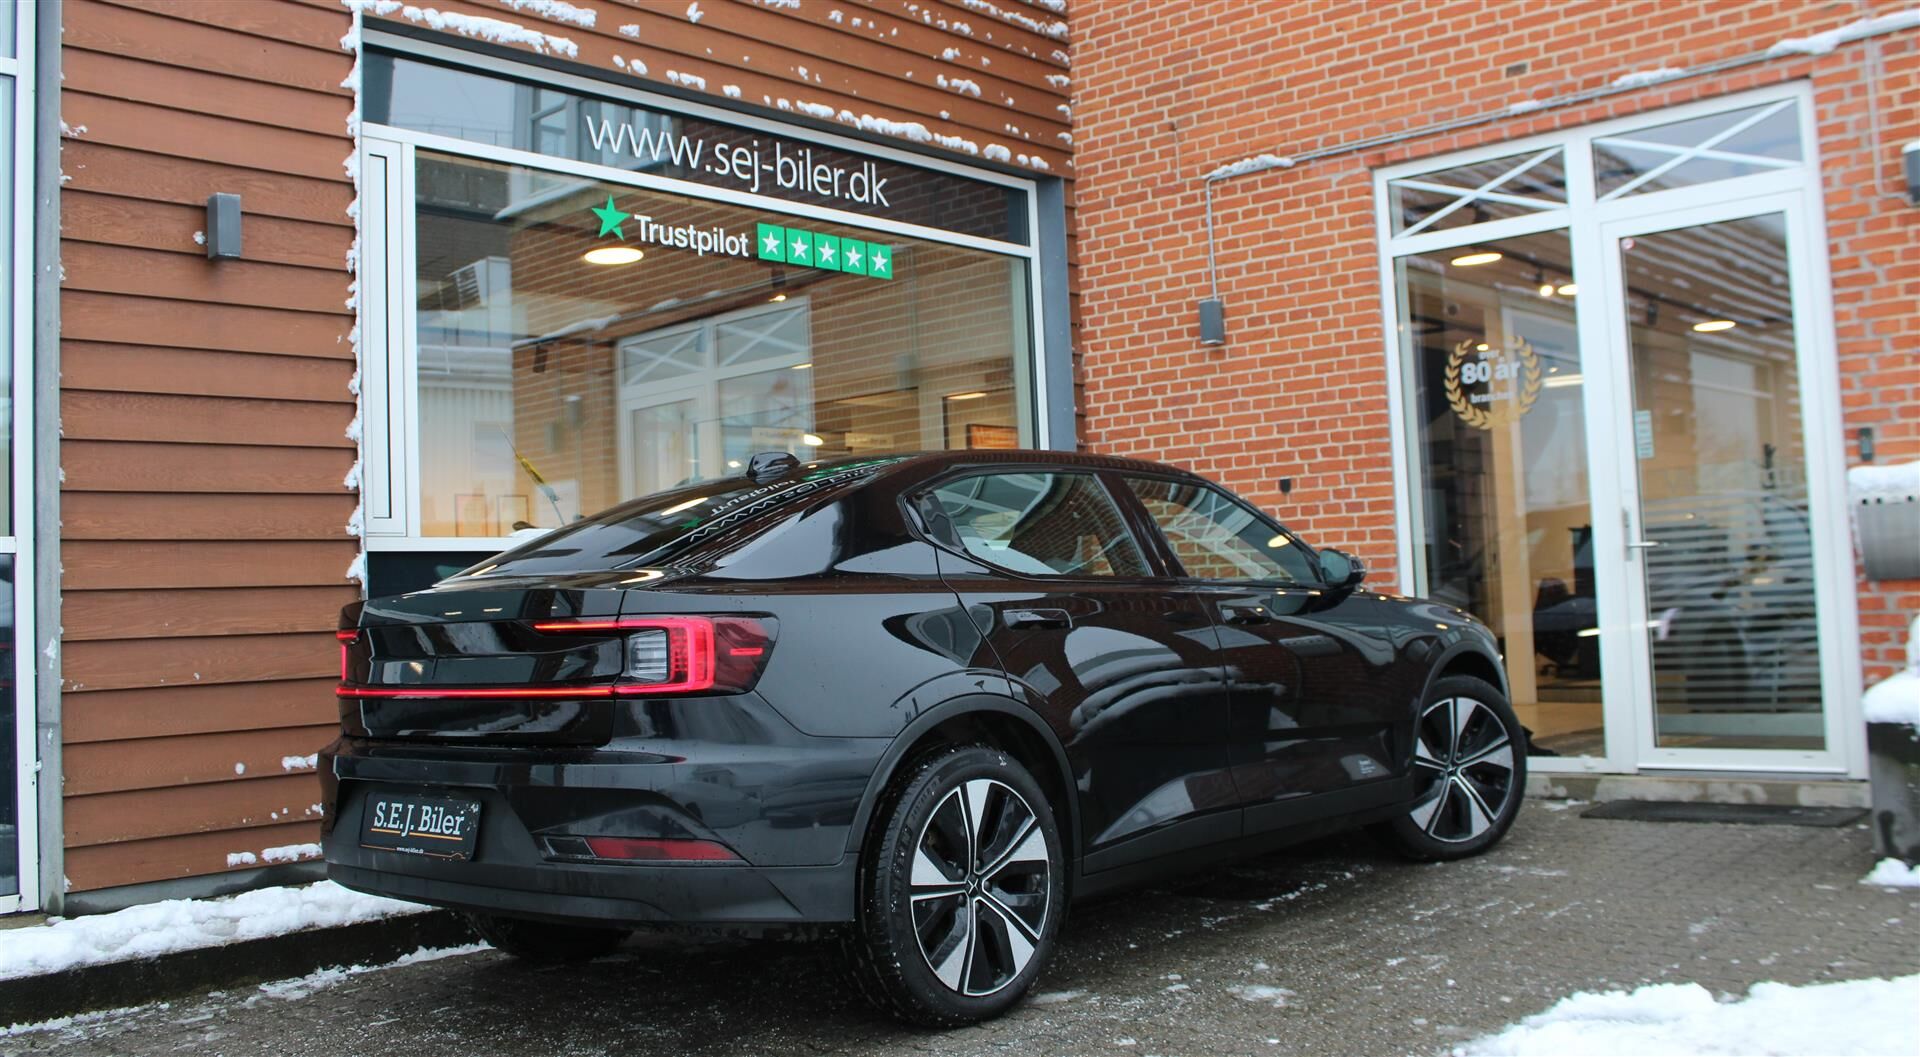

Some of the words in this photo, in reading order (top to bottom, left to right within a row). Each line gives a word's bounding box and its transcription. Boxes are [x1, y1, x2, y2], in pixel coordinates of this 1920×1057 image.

[586, 115, 890, 208] www.sej-biler.dk
[634, 214, 749, 257] Trustpilot
[1461, 362, 1490, 384] 80
[1495, 356, 1521, 379] år
[374, 801, 415, 837] S.E.J.
[418, 805, 465, 835] Biler
